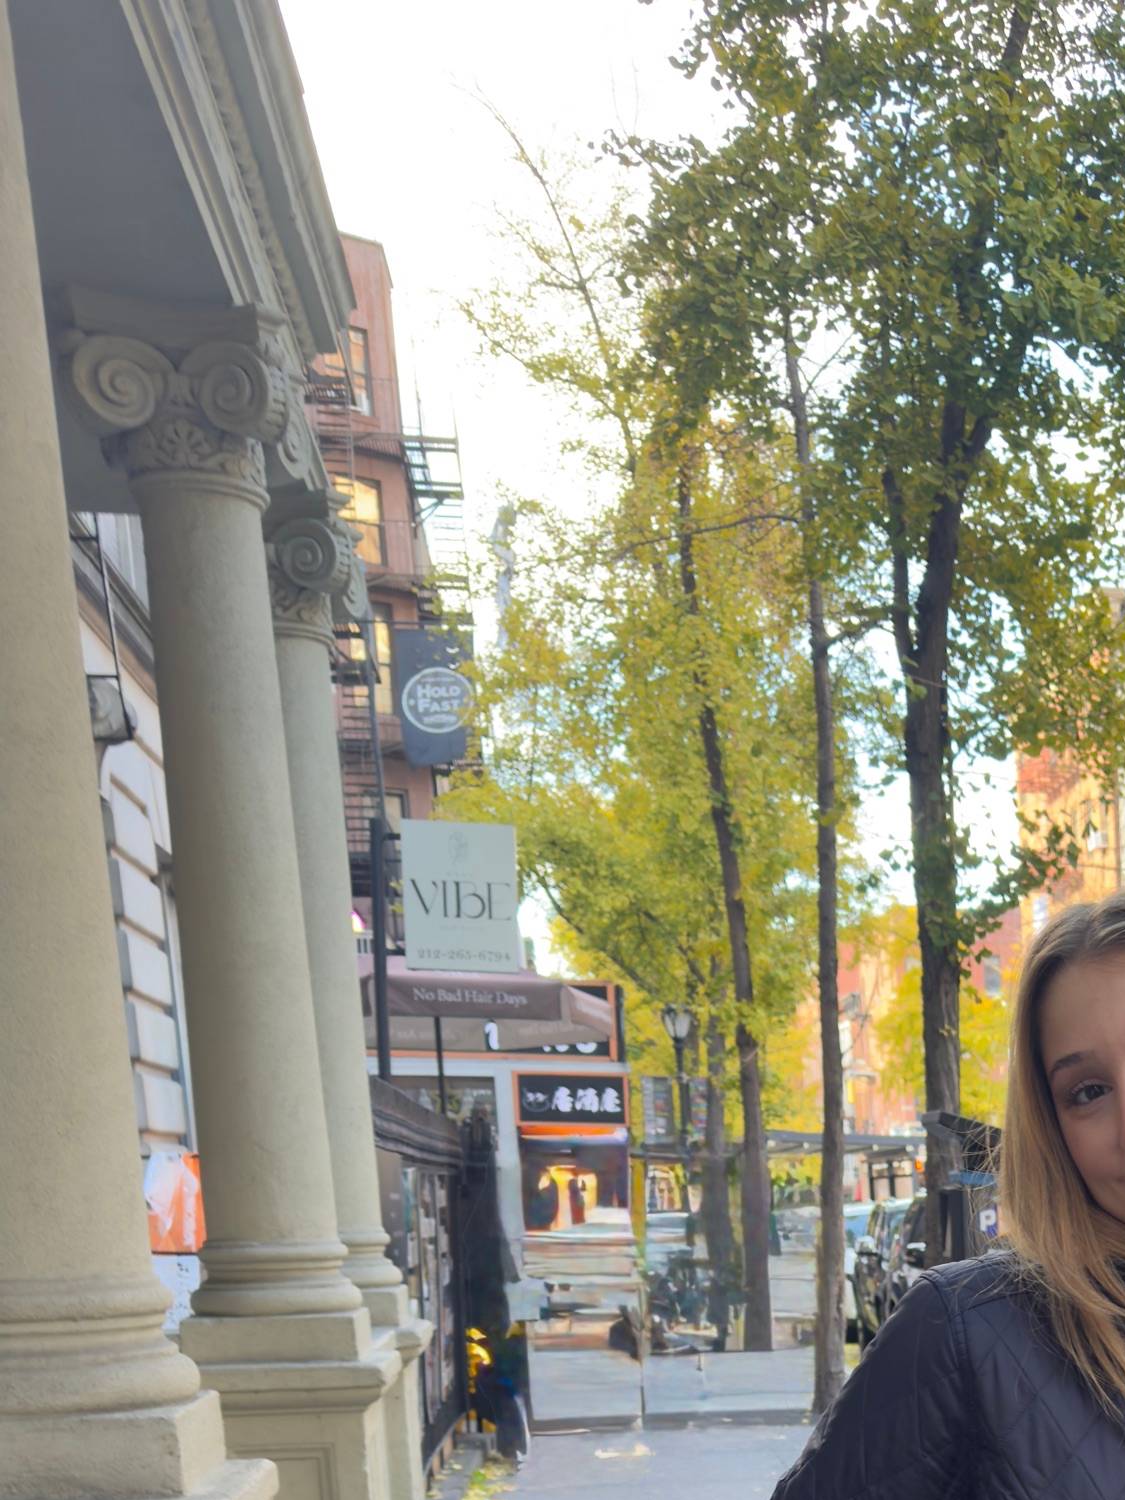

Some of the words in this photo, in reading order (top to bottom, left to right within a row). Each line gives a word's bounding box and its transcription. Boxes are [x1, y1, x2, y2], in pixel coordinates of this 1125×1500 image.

[417, 684, 461, 698] HOLD
[417, 698, 461, 713] FAST
[410, 878, 512, 921] VIBE
[412, 986, 435, 1000] No
[437, 987, 462, 1002] Bad
[464, 989, 494, 1004] Hair
[496, 991, 528, 1008] Days
